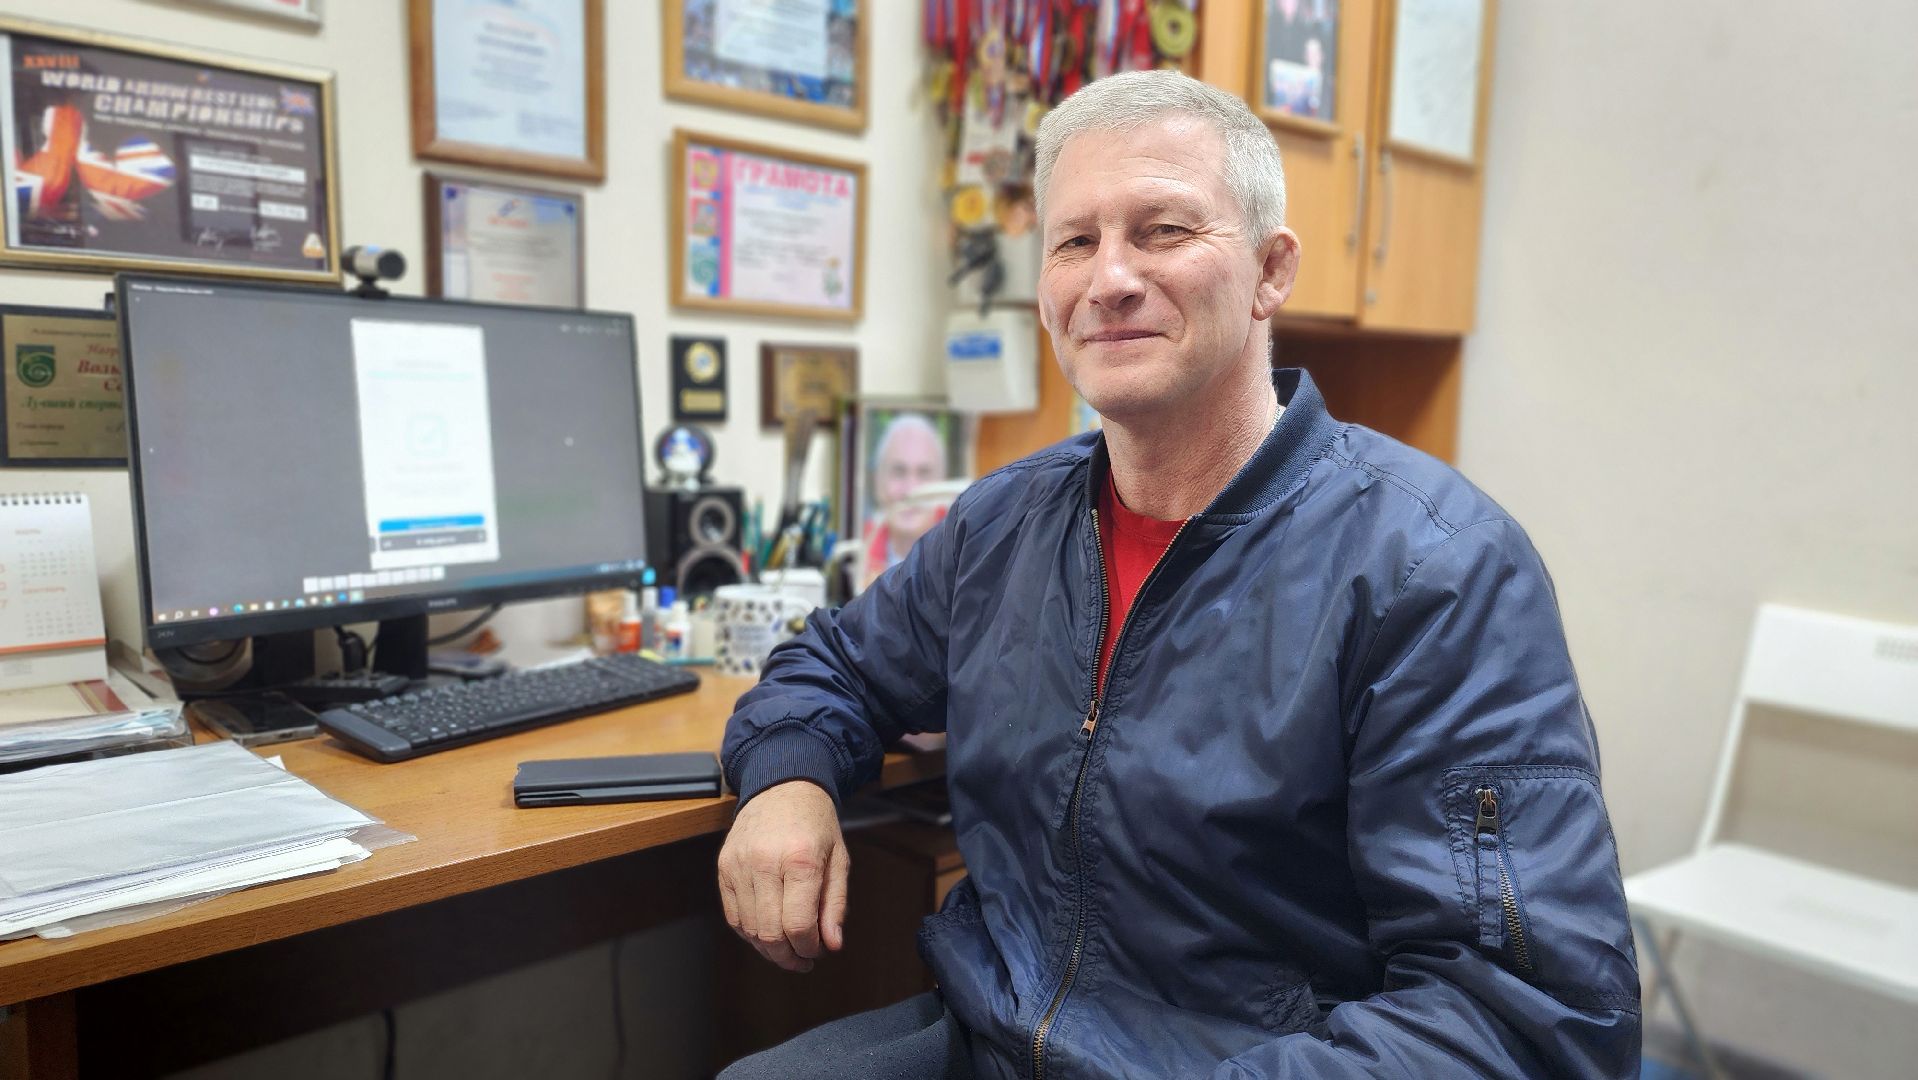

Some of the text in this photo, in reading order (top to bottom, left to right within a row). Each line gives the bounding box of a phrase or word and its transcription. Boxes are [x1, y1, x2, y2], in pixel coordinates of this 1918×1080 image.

[41, 70, 120, 93] WORLD
[94, 94, 304, 134] CHAMPIONSHIPS
[736, 159, 849, 198] ГРАМОТА
